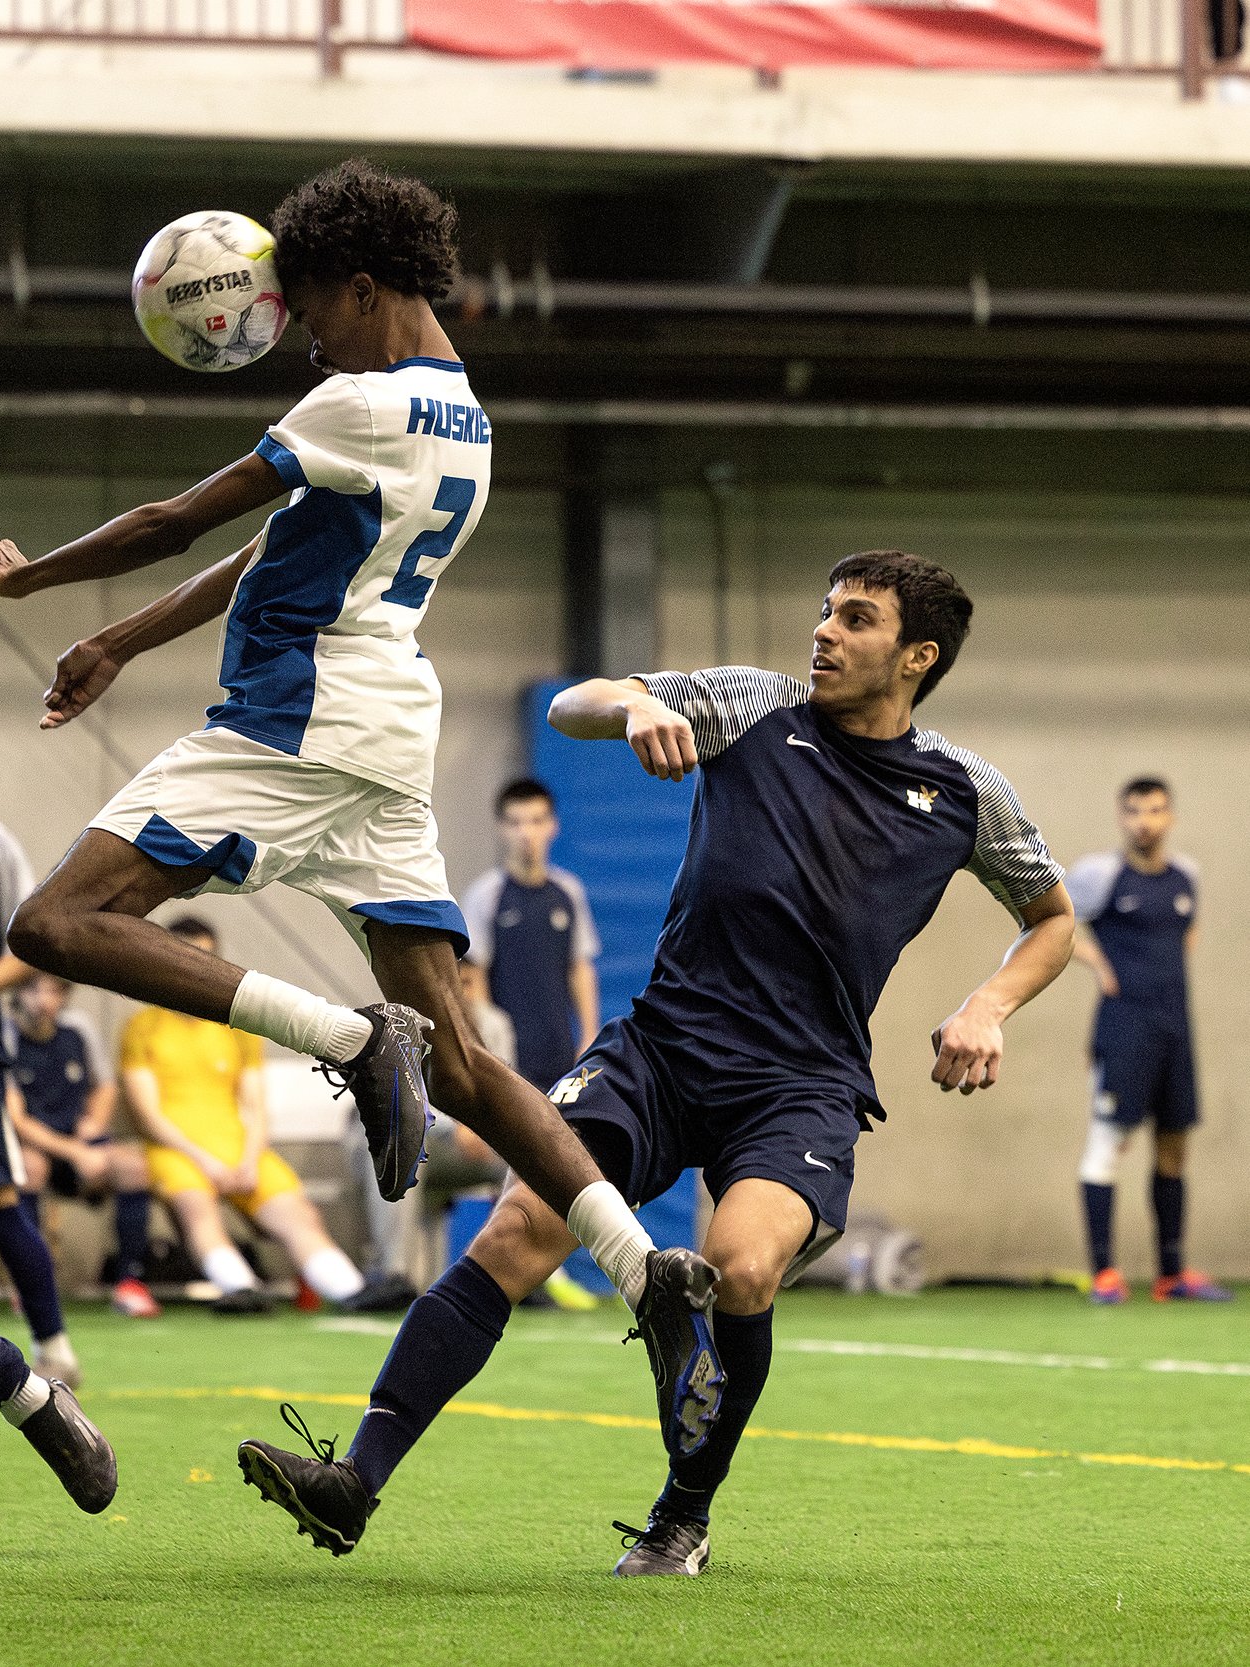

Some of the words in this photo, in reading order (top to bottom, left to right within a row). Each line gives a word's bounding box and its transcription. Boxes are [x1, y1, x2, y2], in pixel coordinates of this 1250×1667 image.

[165, 269, 253, 304] DERBYSTAR
[406, 397, 492, 444] HUSKIE
[380, 475, 477, 609] 2
[906, 789, 932, 813] H
[549, 1077, 583, 1104] H
